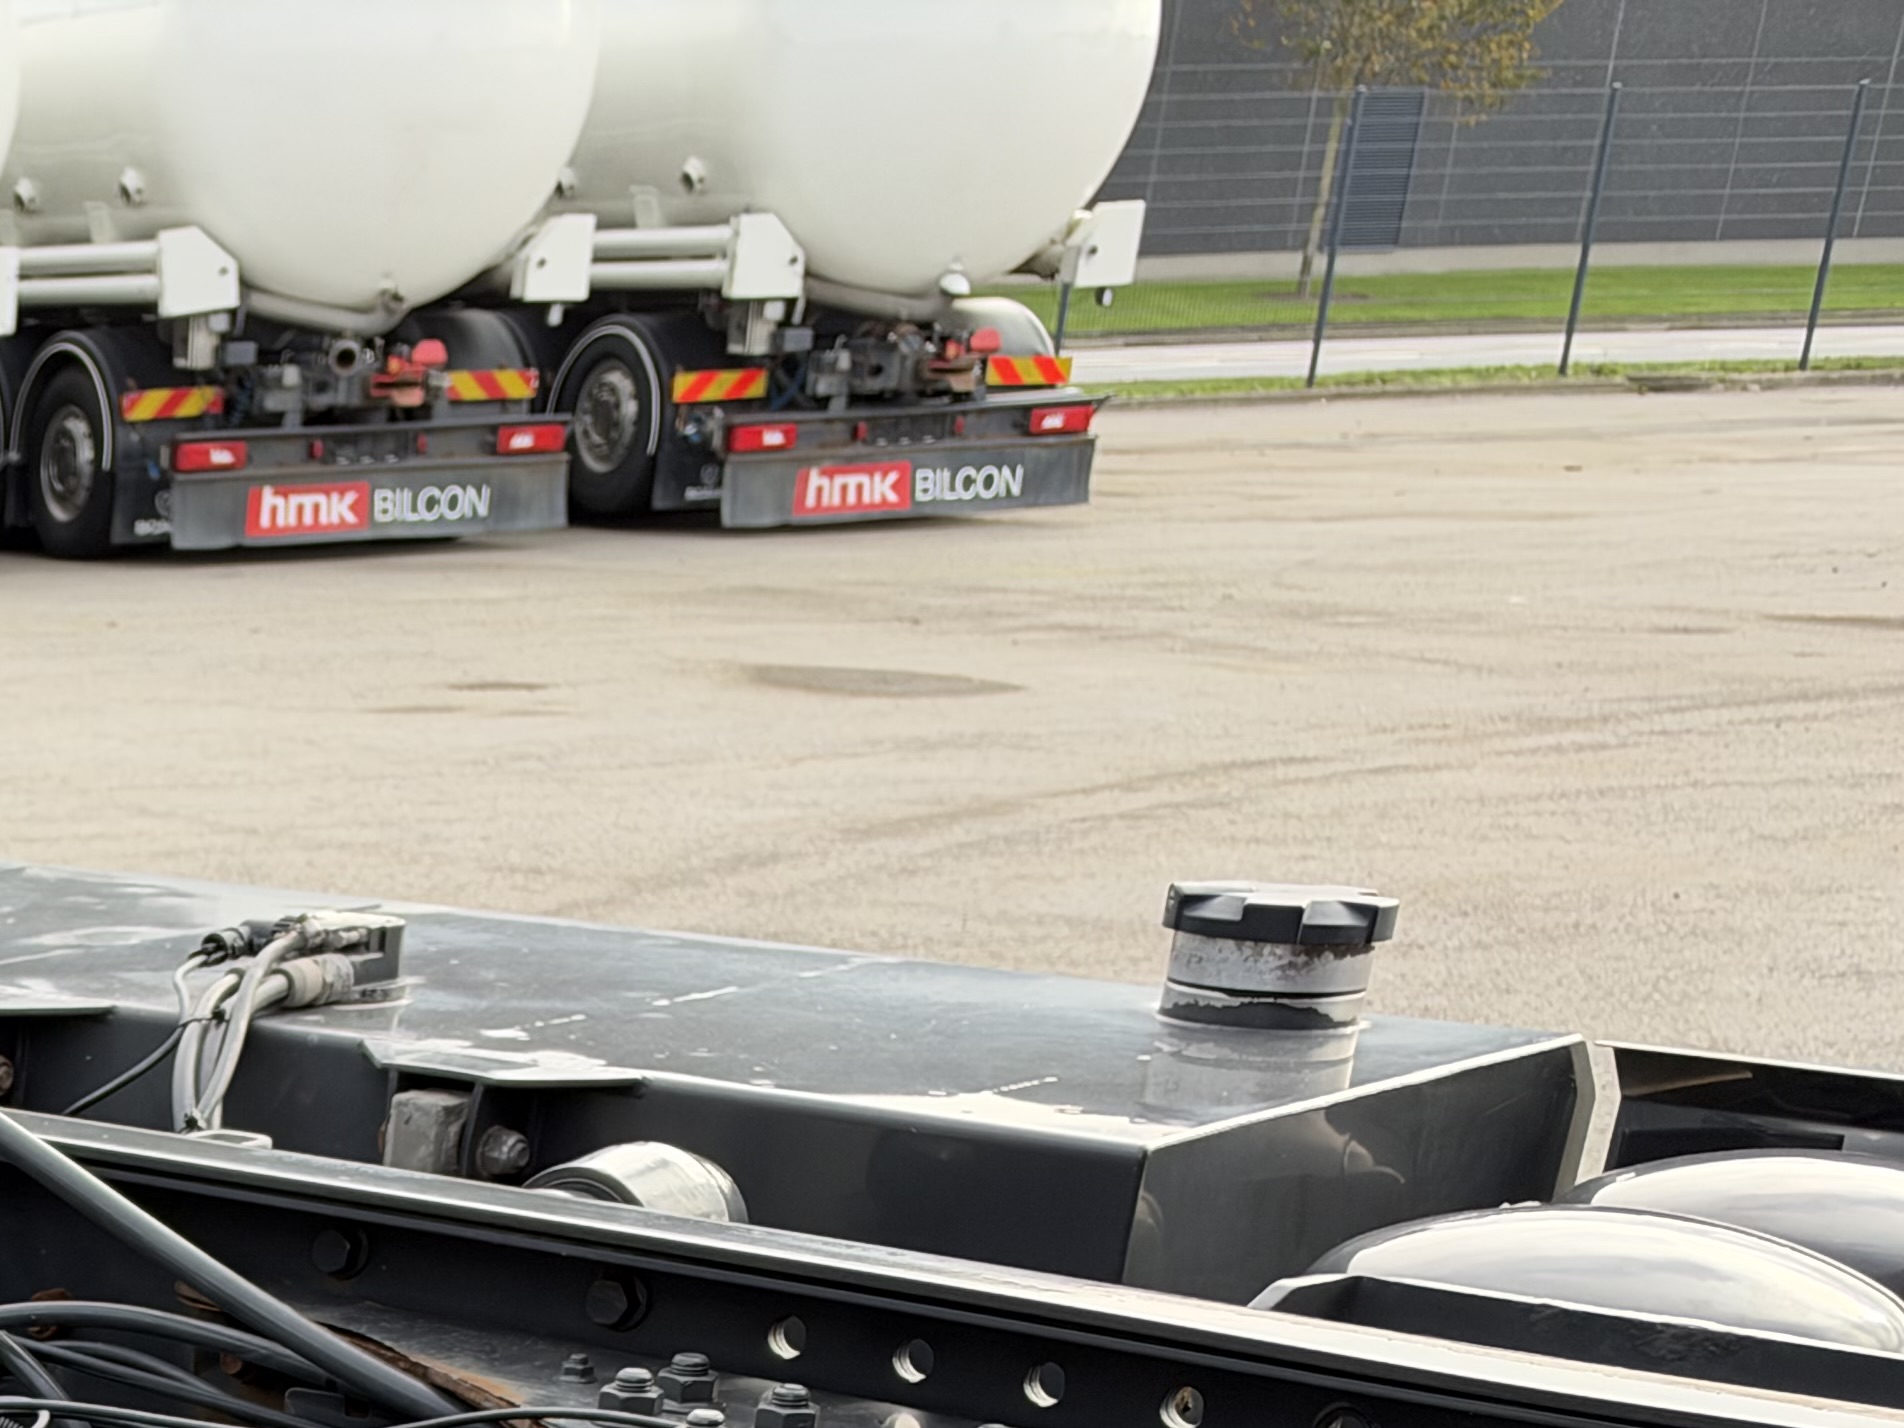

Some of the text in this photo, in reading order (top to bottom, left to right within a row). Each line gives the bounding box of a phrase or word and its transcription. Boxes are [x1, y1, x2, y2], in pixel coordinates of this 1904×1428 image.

[259, 484, 491, 529] hmk BILCON
[804, 464, 1024, 508] hmk BILCON
